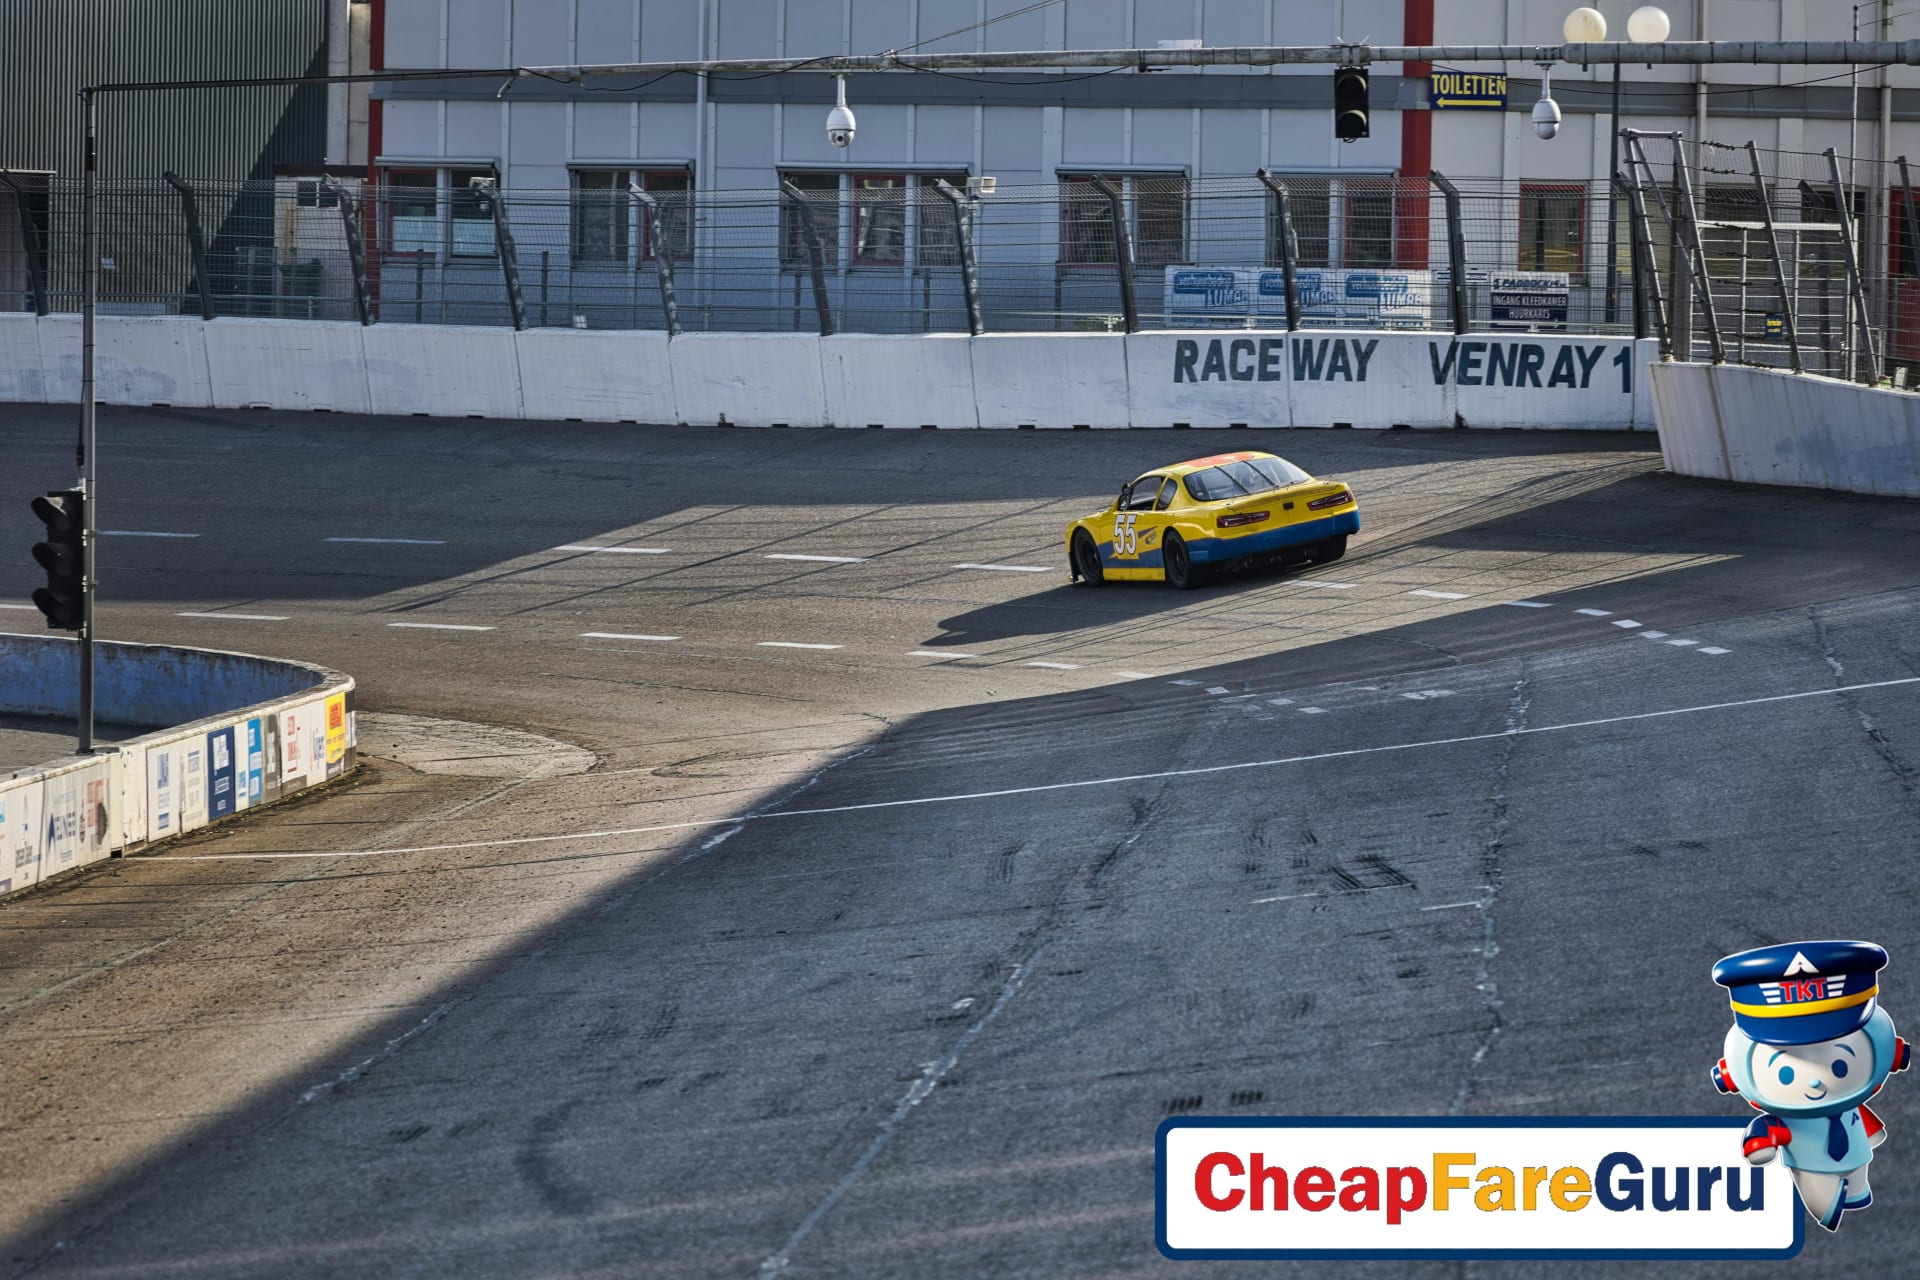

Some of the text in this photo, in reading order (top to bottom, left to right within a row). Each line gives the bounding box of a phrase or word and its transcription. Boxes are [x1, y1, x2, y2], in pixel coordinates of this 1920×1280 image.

[1431, 74, 1507, 95] TOILETTEN
[1493, 295, 1567, 306] INGANG KLEEDKAMER
[1428, 341, 1606, 389] VENRAY
[1612, 346, 1632, 394] 1
[1114, 514, 1137, 555] 55
